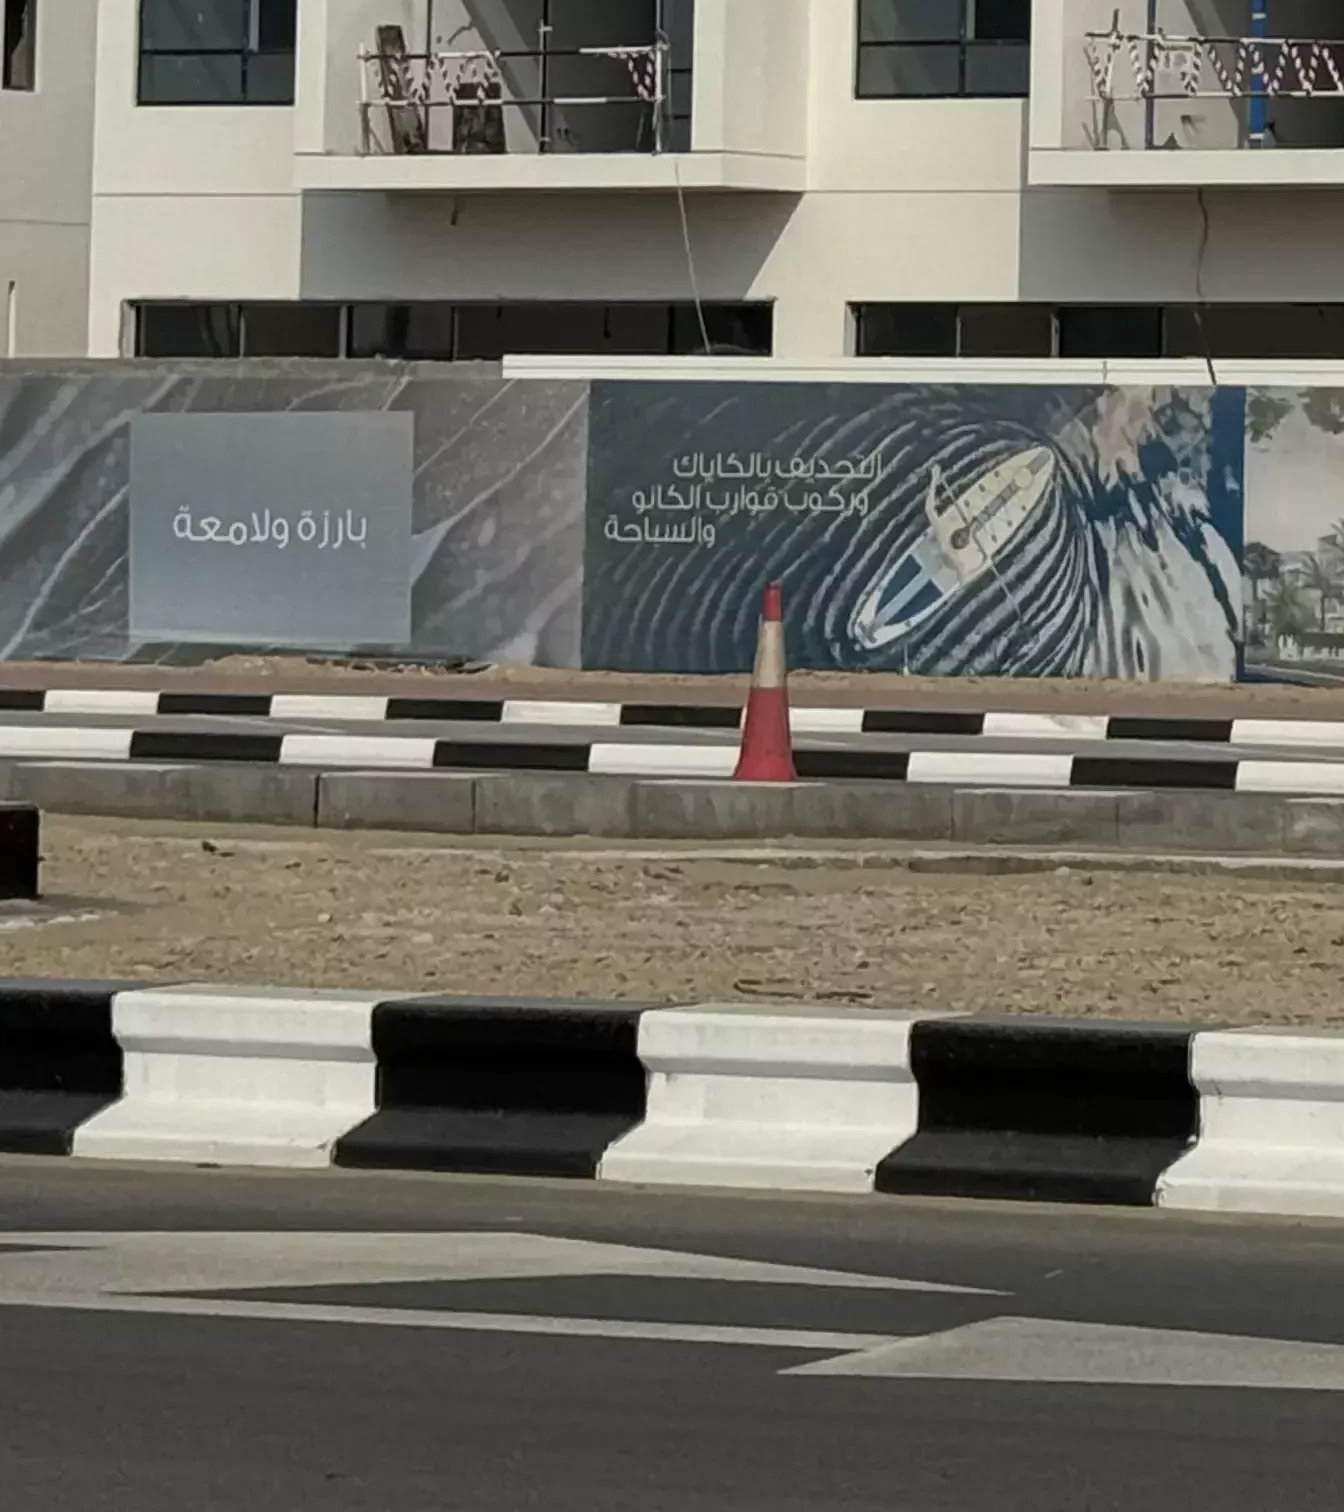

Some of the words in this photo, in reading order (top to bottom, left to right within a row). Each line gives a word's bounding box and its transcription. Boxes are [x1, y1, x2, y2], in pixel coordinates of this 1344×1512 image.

[672, 452, 773, 484] بالكاياك
[705, 484, 779, 516] قوارب
[784, 484, 870, 516] وركوب
[172, 504, 290, 549] ولامعة
[296, 507, 367, 549] بارزة
[603, 513, 717, 549] والسباحة
